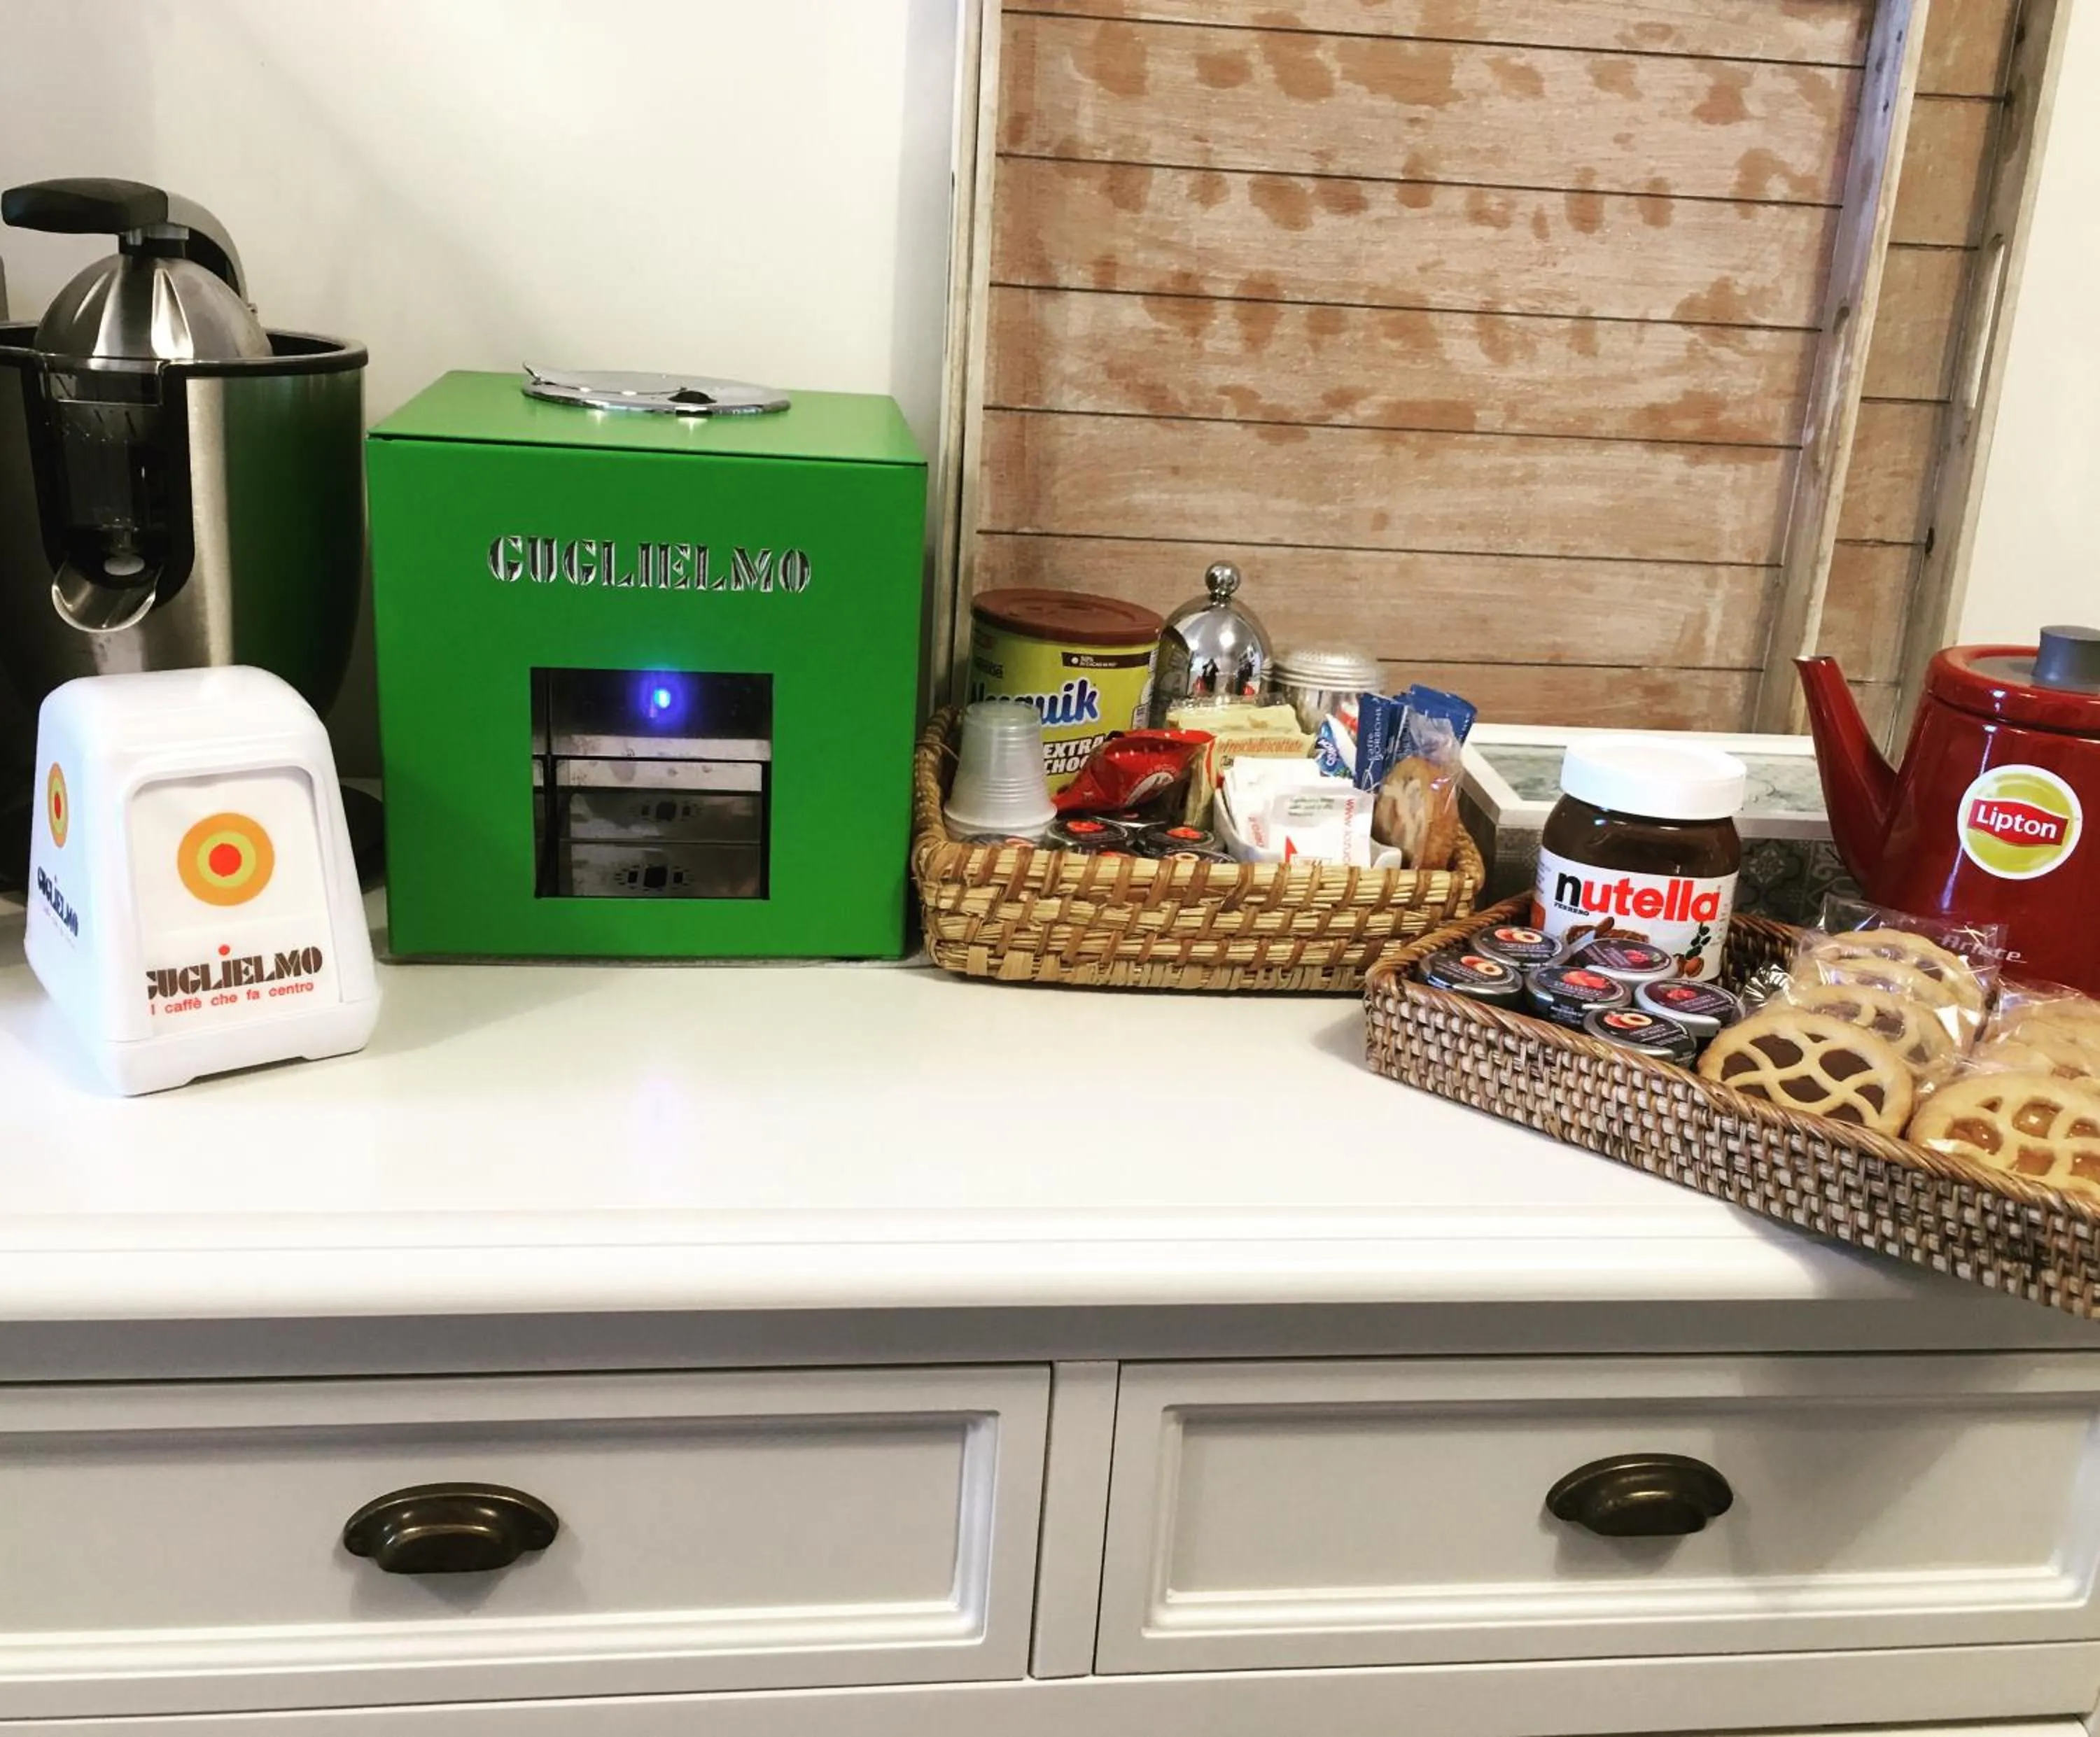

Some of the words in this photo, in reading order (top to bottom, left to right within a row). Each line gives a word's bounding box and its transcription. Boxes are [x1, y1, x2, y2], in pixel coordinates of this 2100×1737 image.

[488, 536, 811, 593] GUGLIELMO
[1043, 736, 1104, 759] EXTRA
[1976, 805, 2057, 839] Lipton
[1554, 901, 1590, 917] FERRERO
[1555, 873, 1721, 922] nutella
[164, 997, 202, 1014] caffè
[211, 992, 238, 1006] che
[246, 988, 260, 1001] fa
[269, 981, 314, 997] centro
